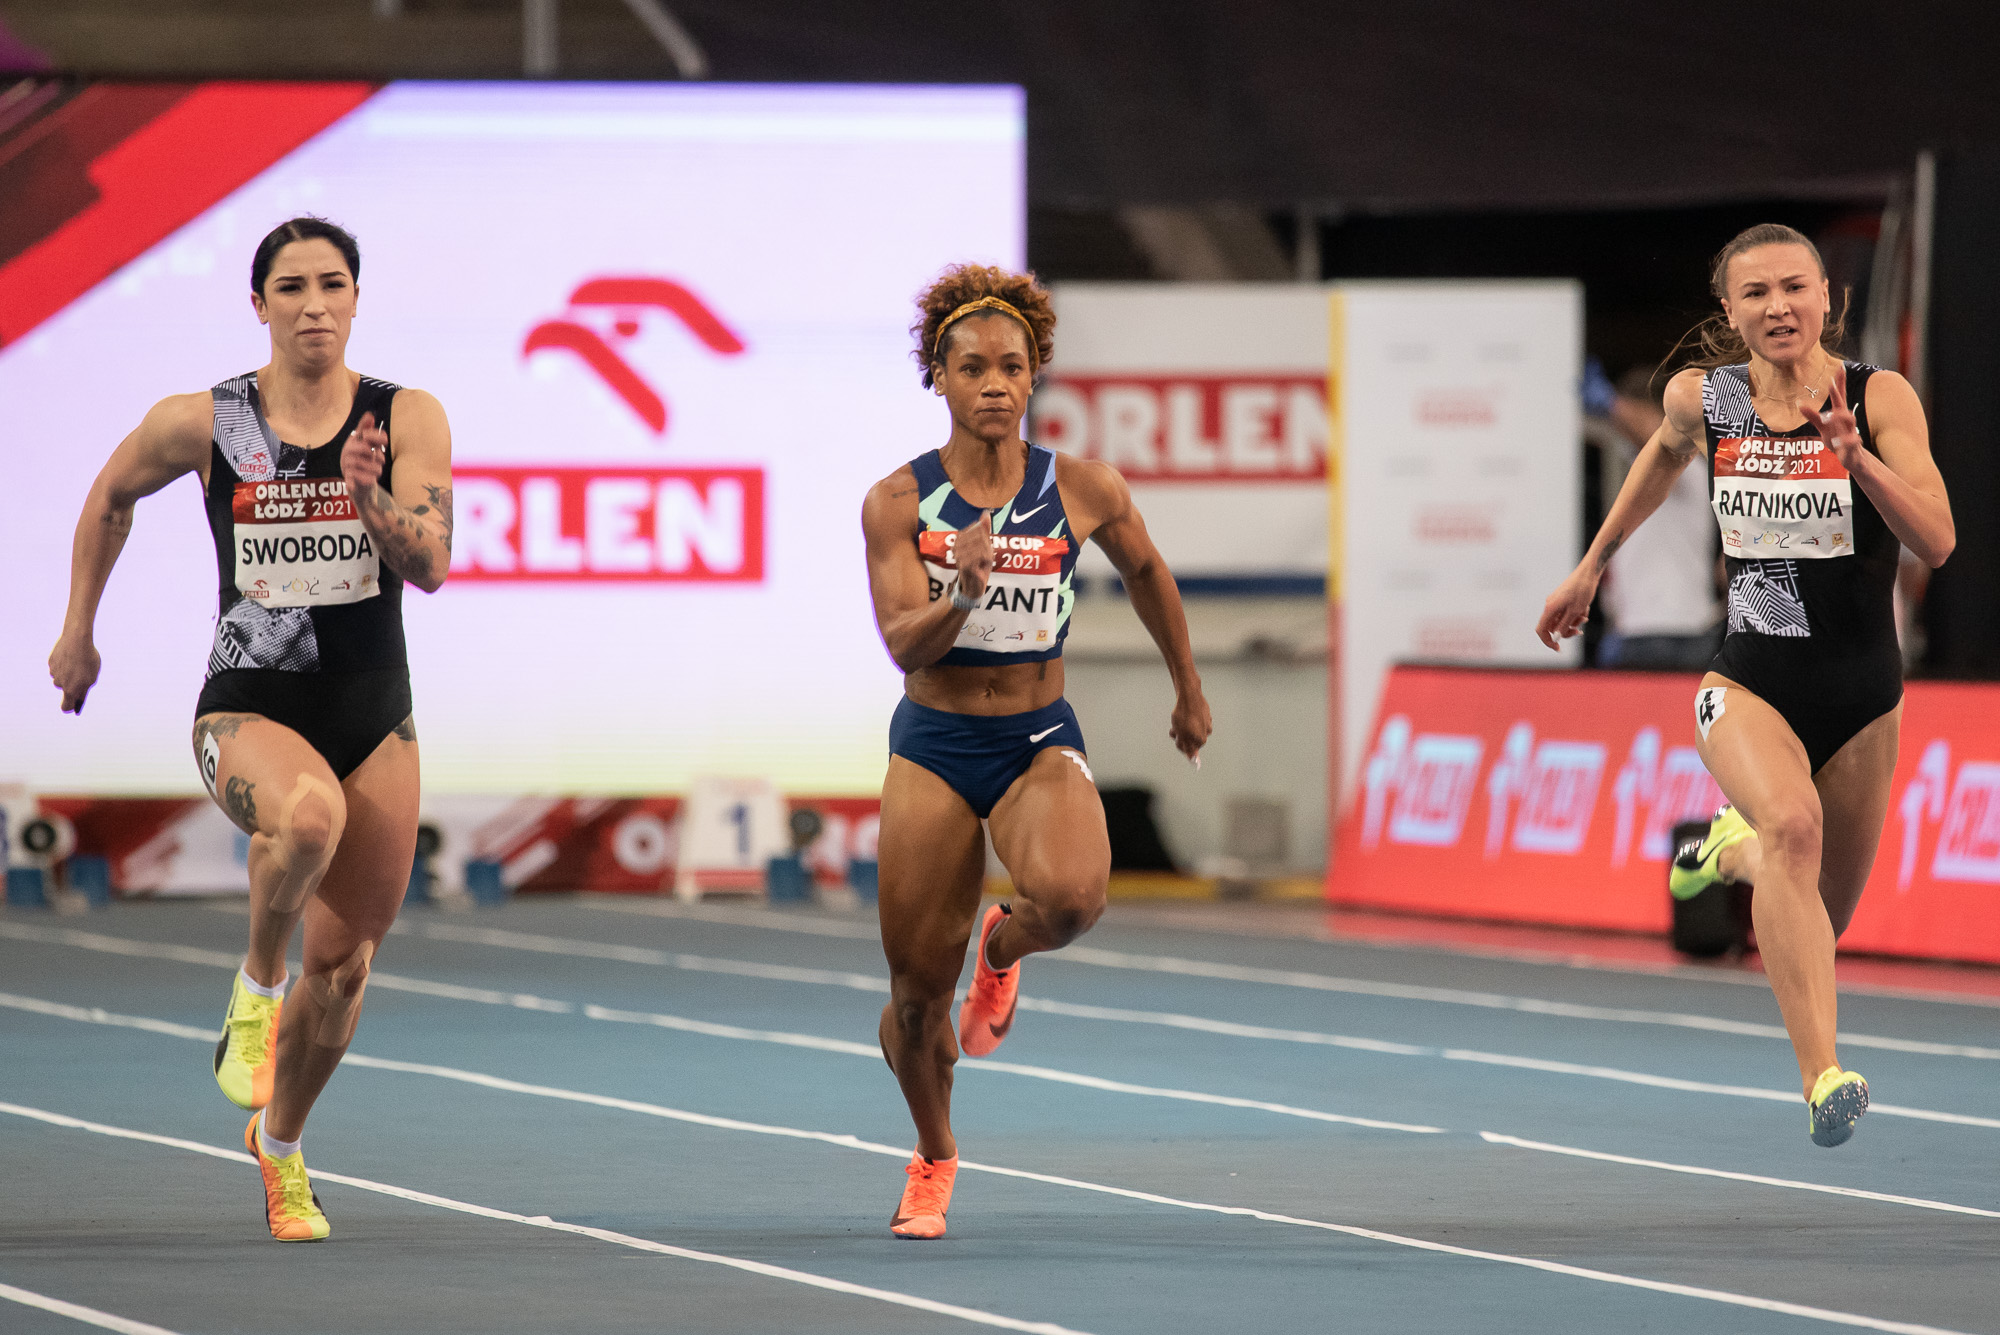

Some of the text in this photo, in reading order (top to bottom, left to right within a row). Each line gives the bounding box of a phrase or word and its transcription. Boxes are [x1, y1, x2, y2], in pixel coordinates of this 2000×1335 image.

[1740, 440, 1796, 456] ORLEN
[1735, 454, 1821, 475] ŁÓDŹ 2021
[255, 483, 316, 500] ORLEN
[254, 499, 351, 519] ŁÓDŹ 2021
[1719, 490, 1844, 520] RATNIKOVA
[451, 475, 745, 575] RLEN
[242, 532, 373, 565] SWOBODA
[1009, 536, 1045, 551] CUP
[1001, 552, 1040, 570] 2021
